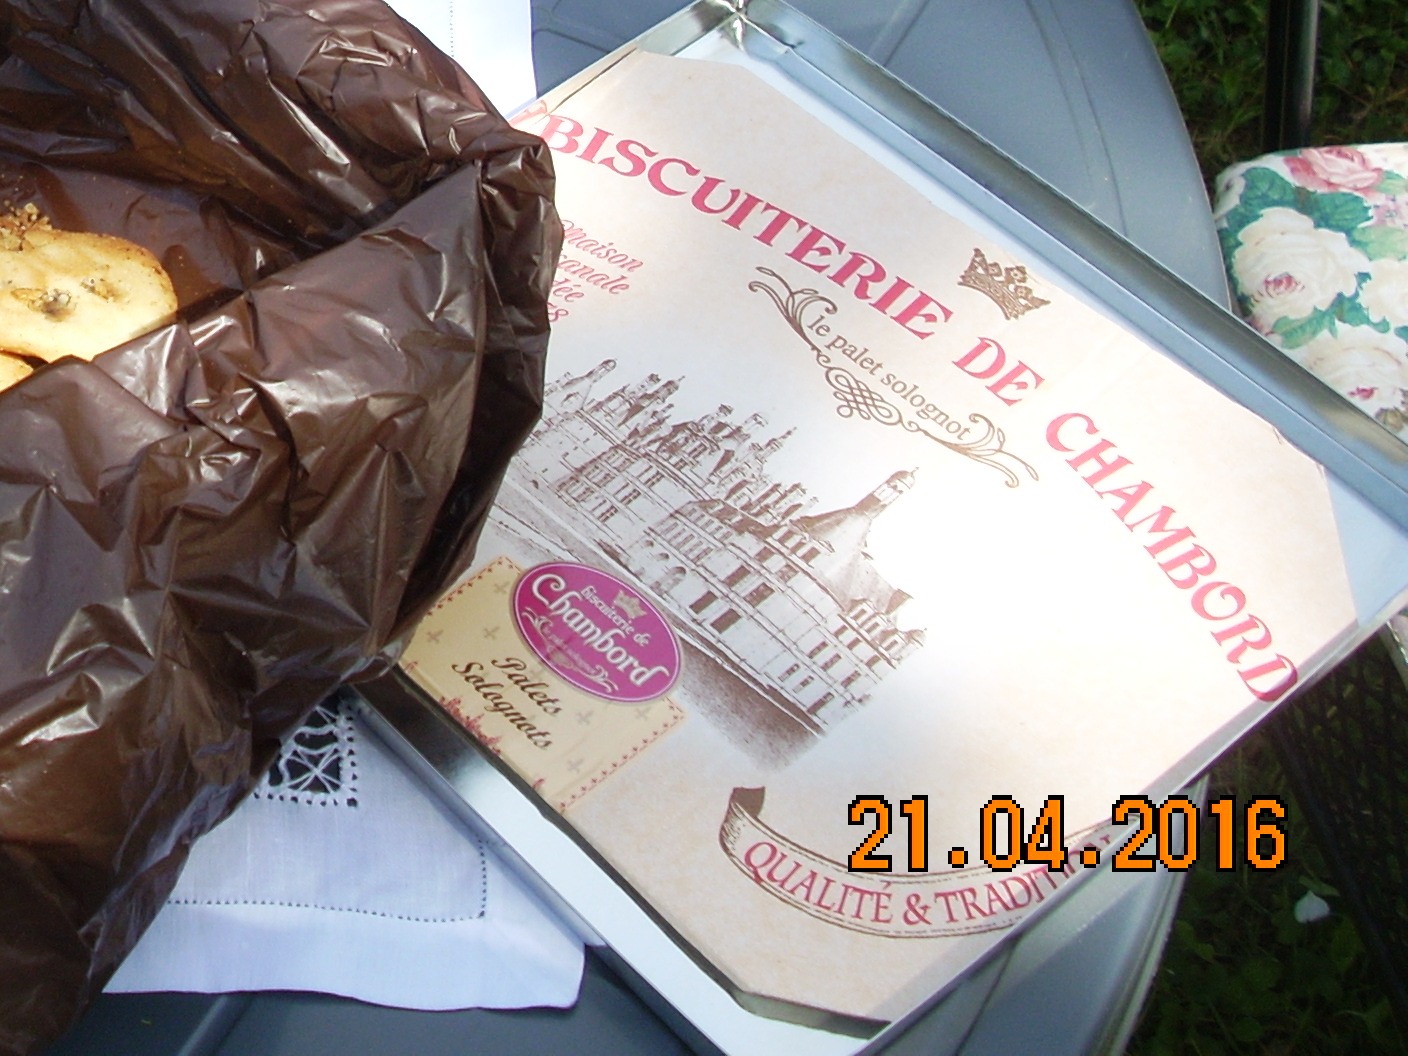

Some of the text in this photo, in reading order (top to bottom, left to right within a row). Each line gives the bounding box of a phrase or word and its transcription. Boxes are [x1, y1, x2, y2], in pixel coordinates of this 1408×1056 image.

[540, 114, 1299, 702] BISCUITERIE DE CHAMBORD
[807, 315, 971, 440] le palet solognot
[532, 573, 670, 687] Chambord
[451, 661, 552, 748] Solognots
[491, 657, 562, 715] Palets
[744, 841, 893, 924] QUALITÉ
[903, 893, 932, 925] &
